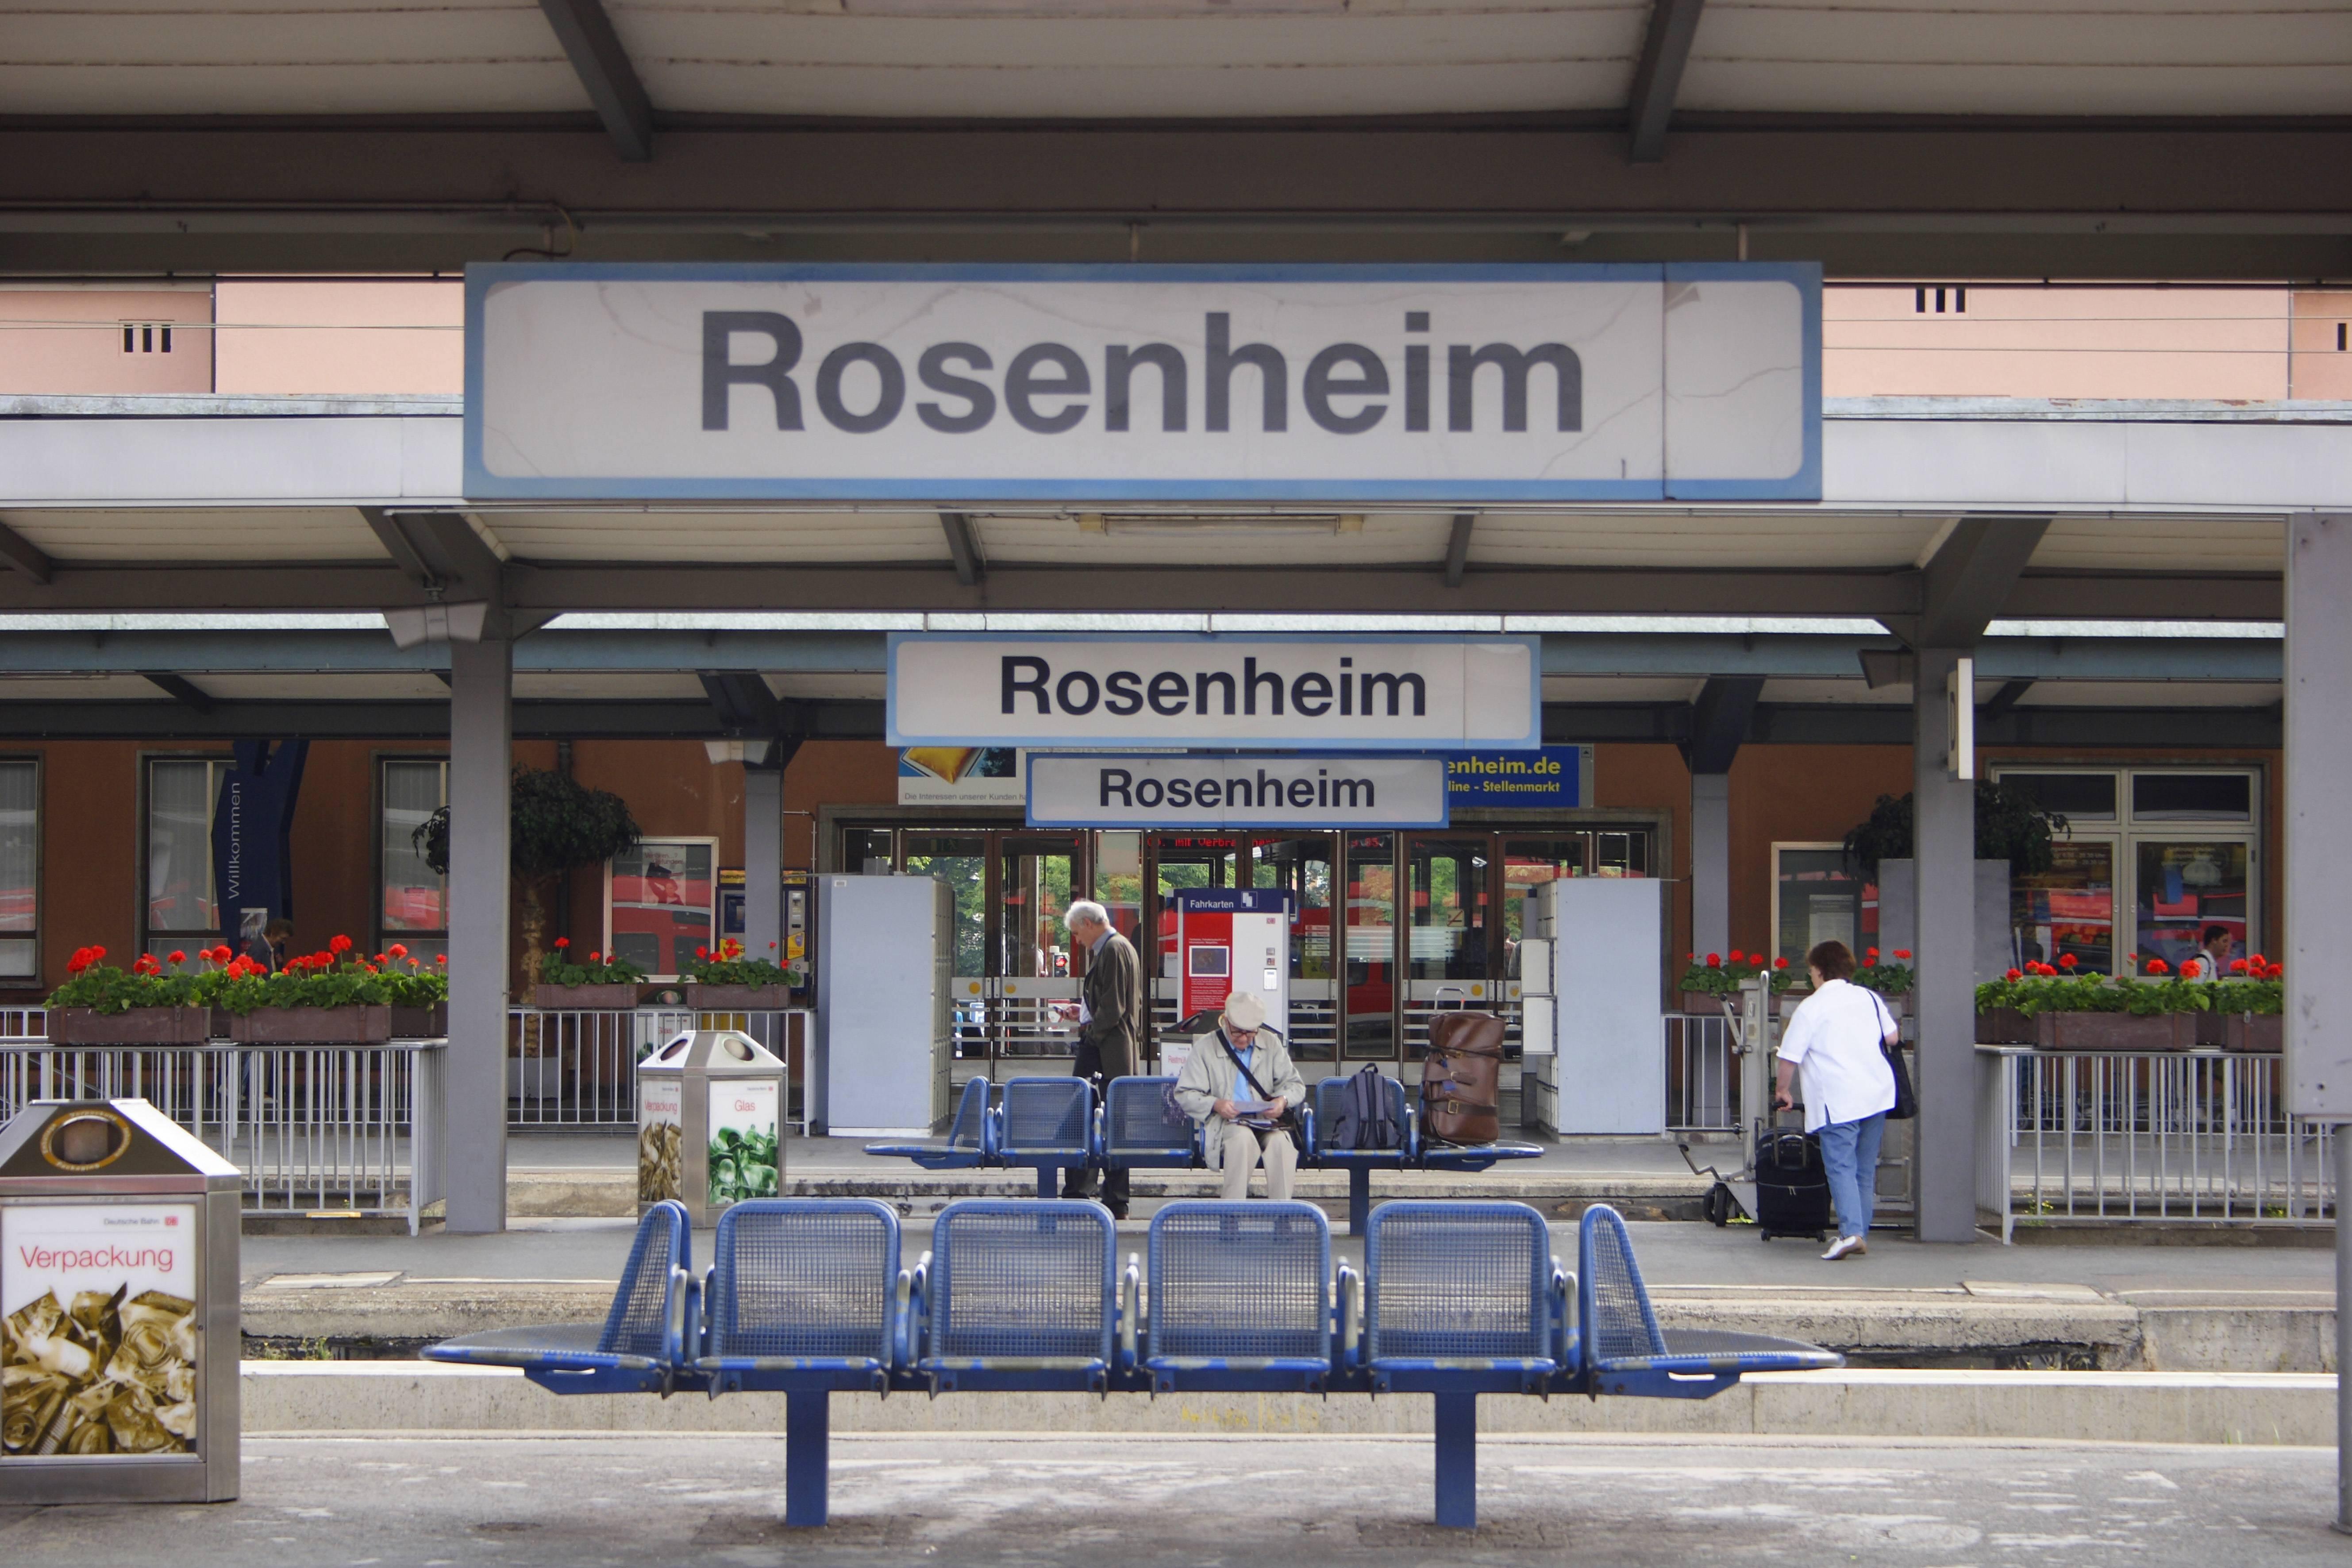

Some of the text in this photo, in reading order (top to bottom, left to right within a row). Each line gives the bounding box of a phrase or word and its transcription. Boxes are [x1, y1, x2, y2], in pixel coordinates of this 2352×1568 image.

[701, 310, 1583, 435] Rosenheim
[1001, 655, 1426, 717] Rosenheim
[1100, 768, 1375, 808] Rosenheim
[1483, 781, 1560, 792] Stellenmarkt
[228, 782, 241, 899] Willkommen
[1190, 899, 1234, 908] Fahrkarten
[644, 1099, 677, 1114] Verpackung
[735, 1099, 755, 1111] Glas
[20, 1245, 173, 1273] Verpackung
